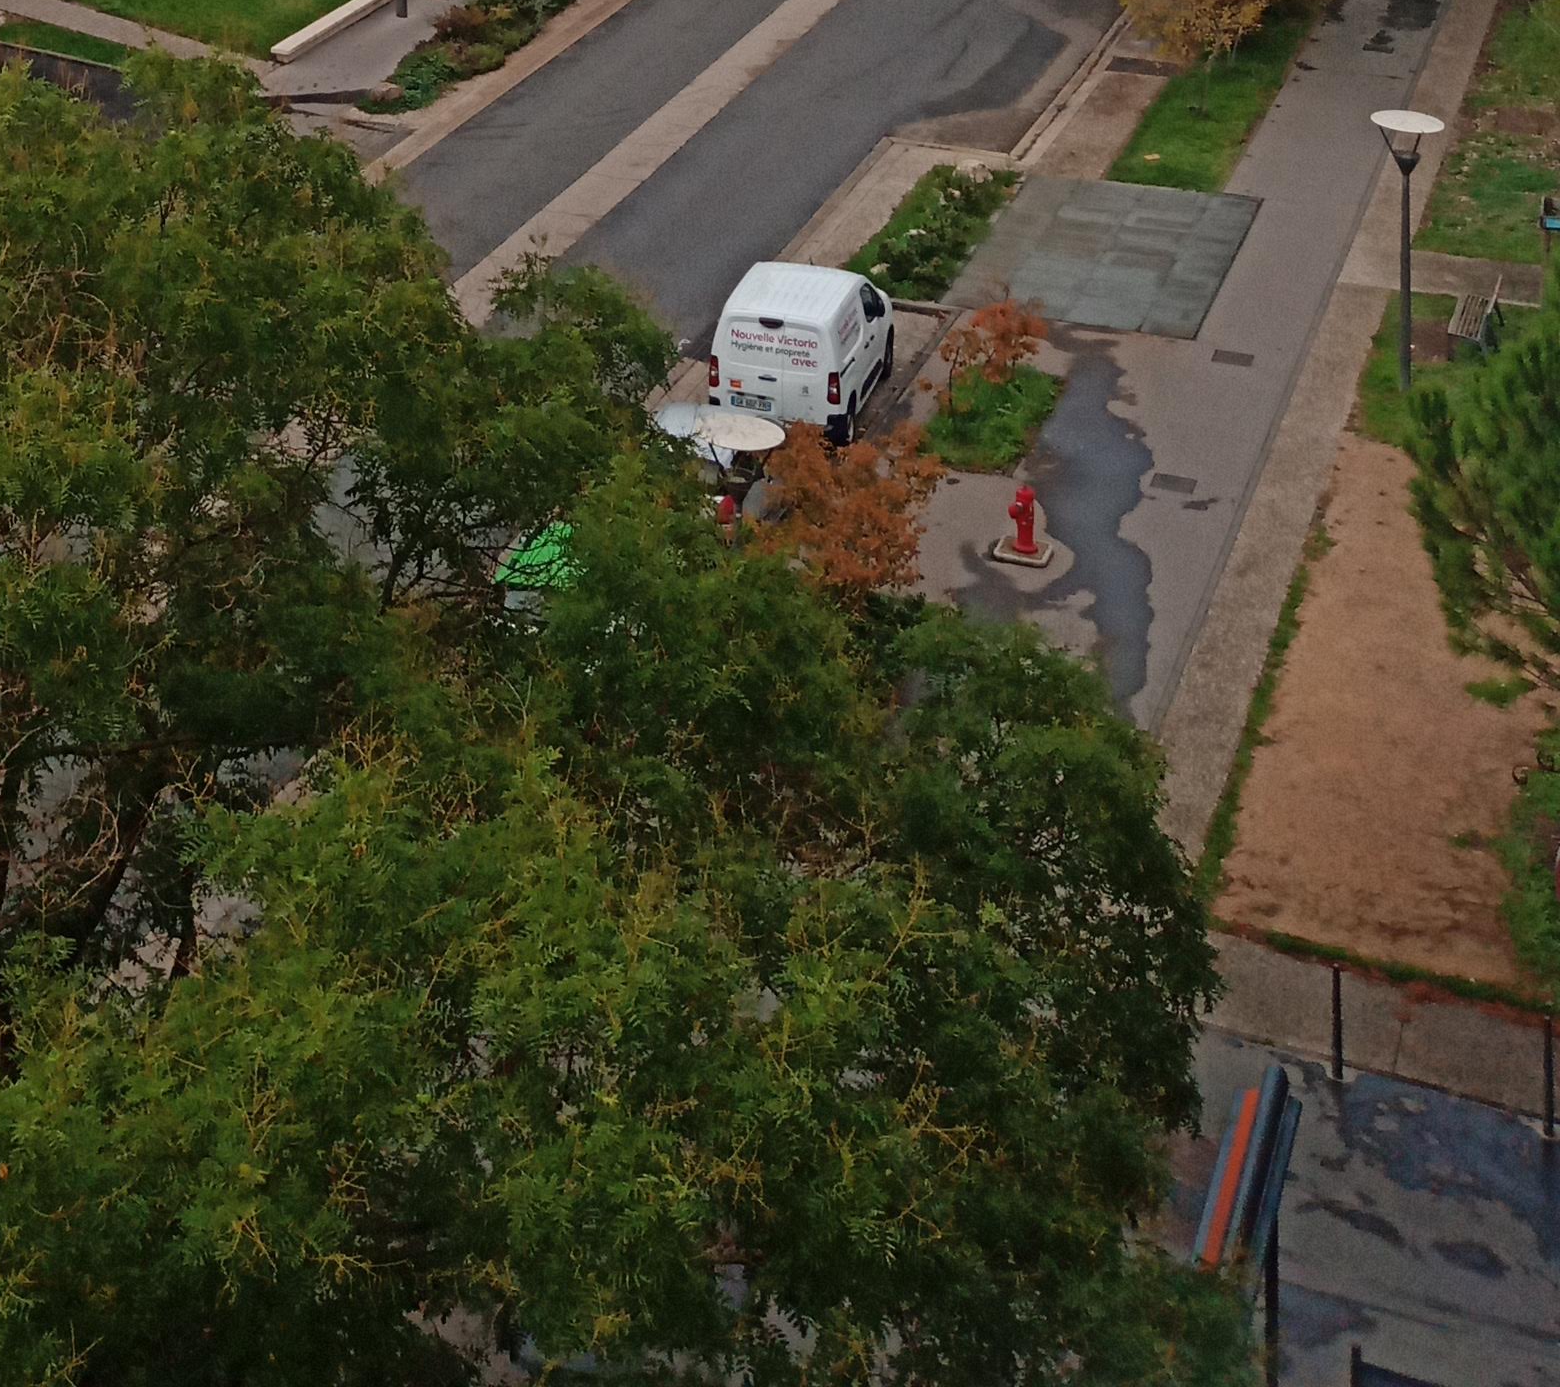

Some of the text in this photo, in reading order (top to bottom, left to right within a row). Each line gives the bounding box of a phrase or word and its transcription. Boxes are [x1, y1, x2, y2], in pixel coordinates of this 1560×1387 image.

[731, 329, 818, 349] Nouvelle Victoria
[791, 357, 818, 368] avec
